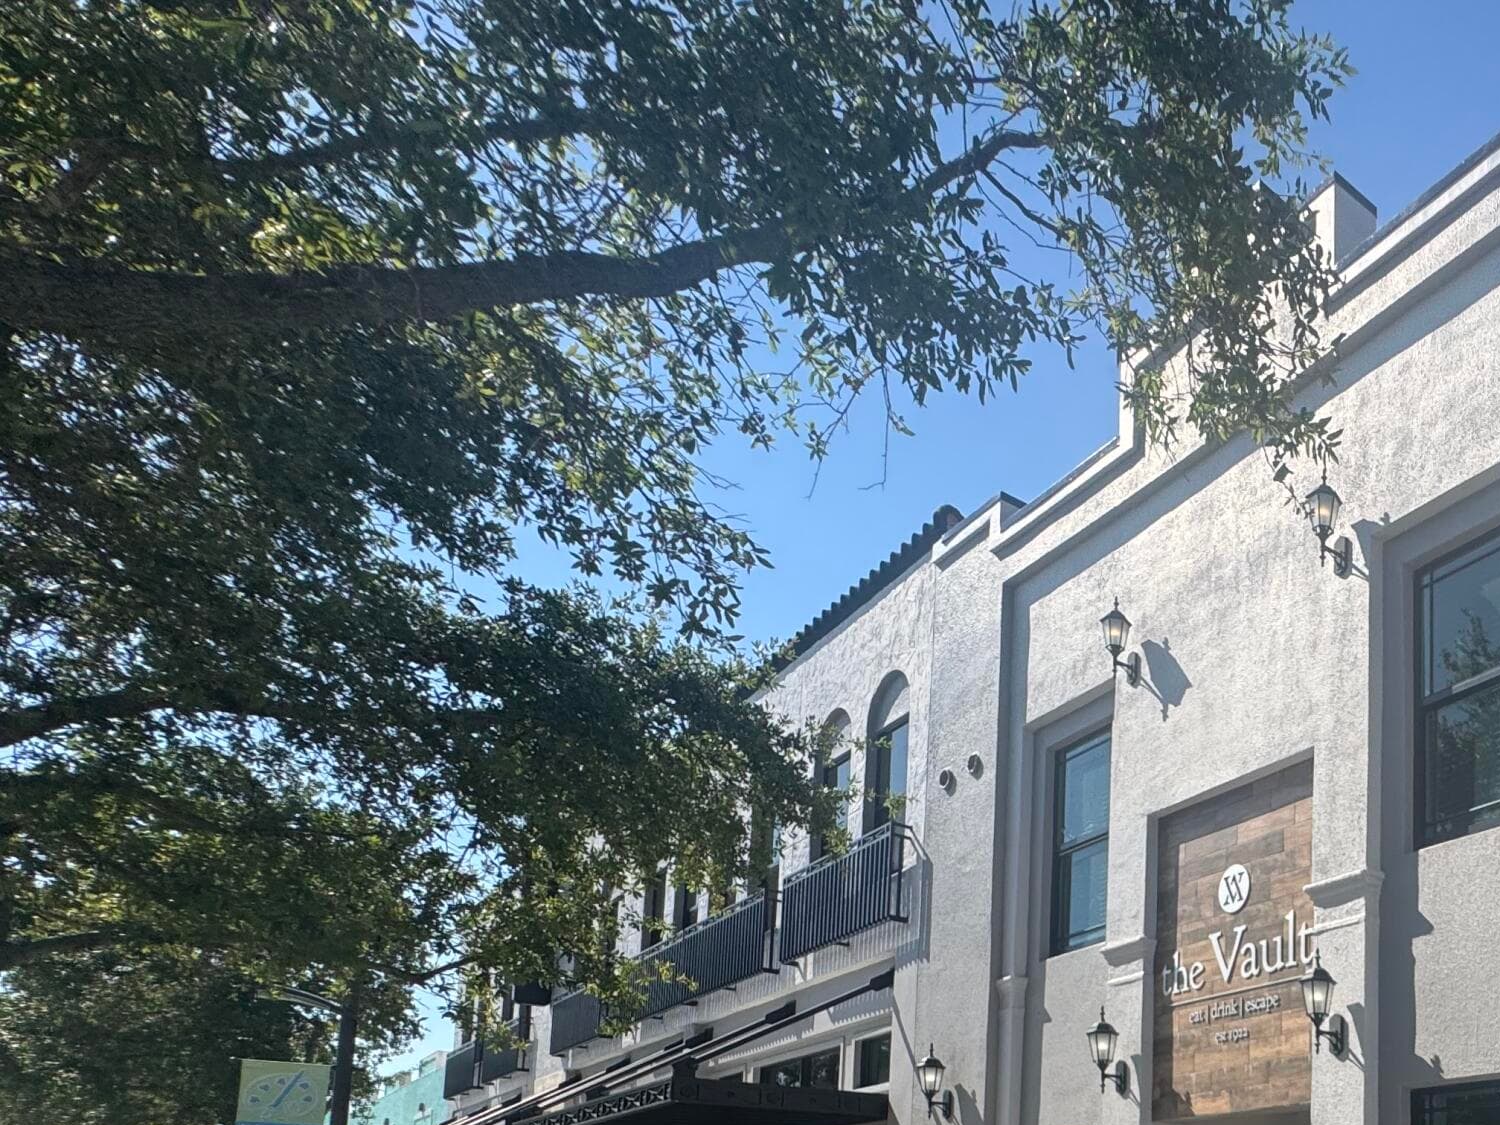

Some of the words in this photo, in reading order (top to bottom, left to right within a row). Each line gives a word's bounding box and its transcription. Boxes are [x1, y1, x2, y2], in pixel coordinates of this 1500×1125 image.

[1162, 950, 1205, 995] the
[1208, 909, 1317, 984] Vault
[1189, 1010, 1205, 1024] eat
[1211, 1000, 1238, 1019] drink
[1245, 995, 1279, 1013] escape
